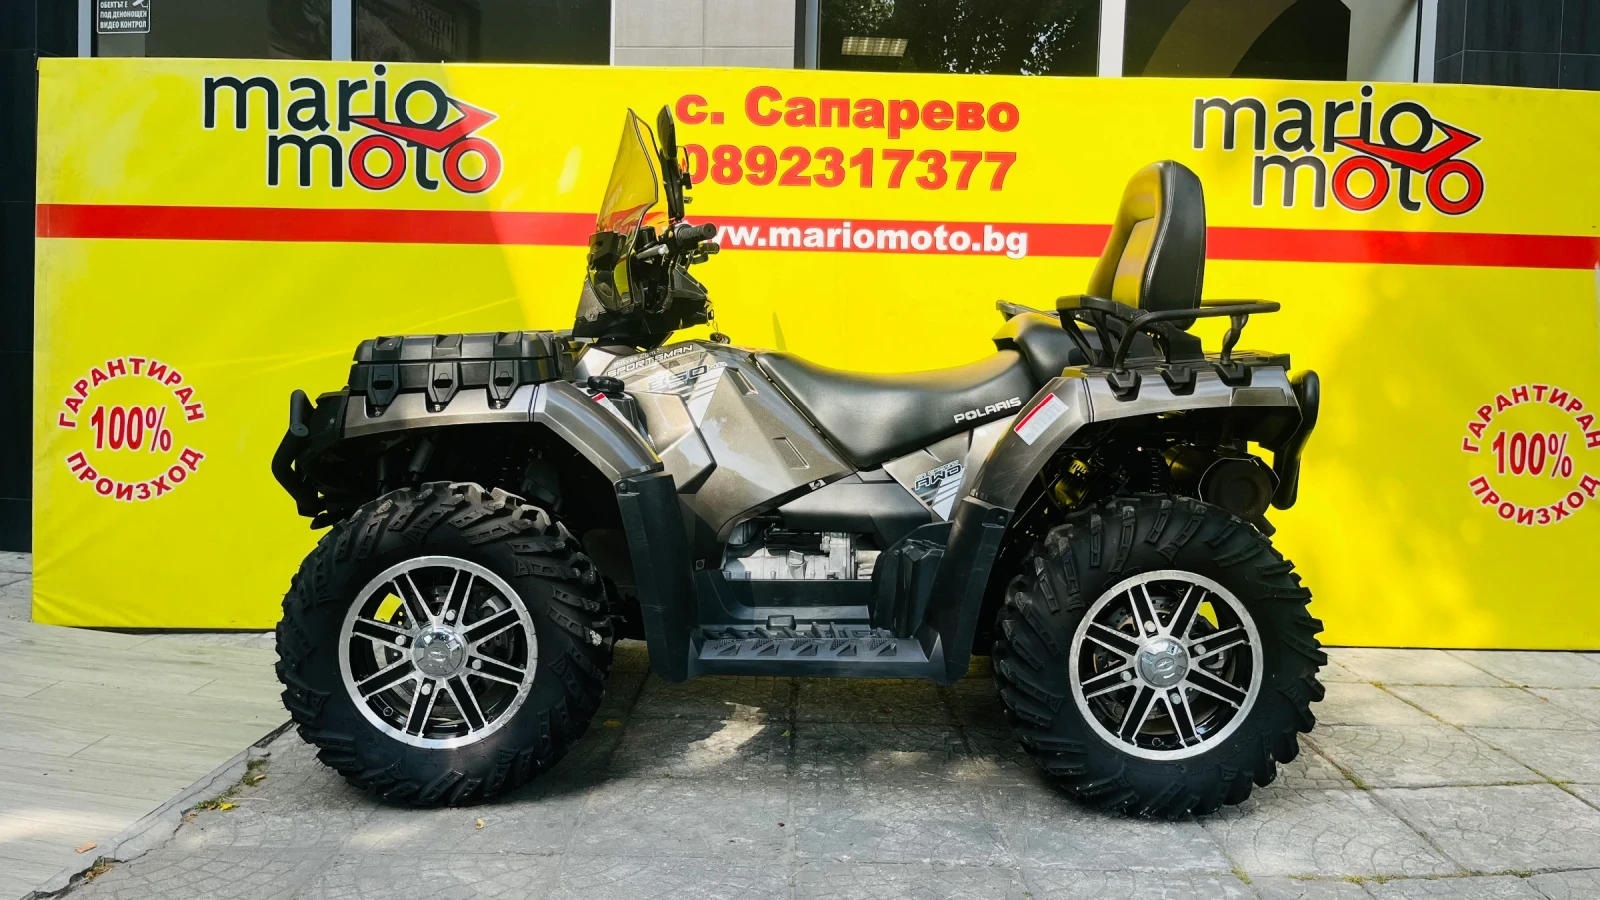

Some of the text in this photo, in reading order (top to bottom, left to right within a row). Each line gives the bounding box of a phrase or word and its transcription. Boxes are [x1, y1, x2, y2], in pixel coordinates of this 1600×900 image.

[100, 10, 147, 19] ПОД ДЕНОНОЩЕН
[100, 20, 147, 30] ВИДЕО КОНТРОЛ
[204, 64, 449, 132] mario
[675, 85, 1020, 139] с. Сапарево
[1193, 85, 1434, 152] mario
[268, 134, 502, 193] moto
[685, 144, 1017, 191] 0892317377
[1253, 155, 1484, 215] moto
[607, 345, 693, 376] SPORTSMAN
[58, 357, 205, 428] ГАРАНТИРАН
[953, 397, 1022, 424] POLARIS
[1462, 384, 1600, 453] ГАРАНТИРАН
[91, 405, 172, 452] 100%
[1492, 431, 1573, 478] 100%
[66, 447, 205, 502] ПРОИЗХОД
[914, 463, 963, 491] AWD
[1469, 474, 1600, 526] ПРОИЗХОД
